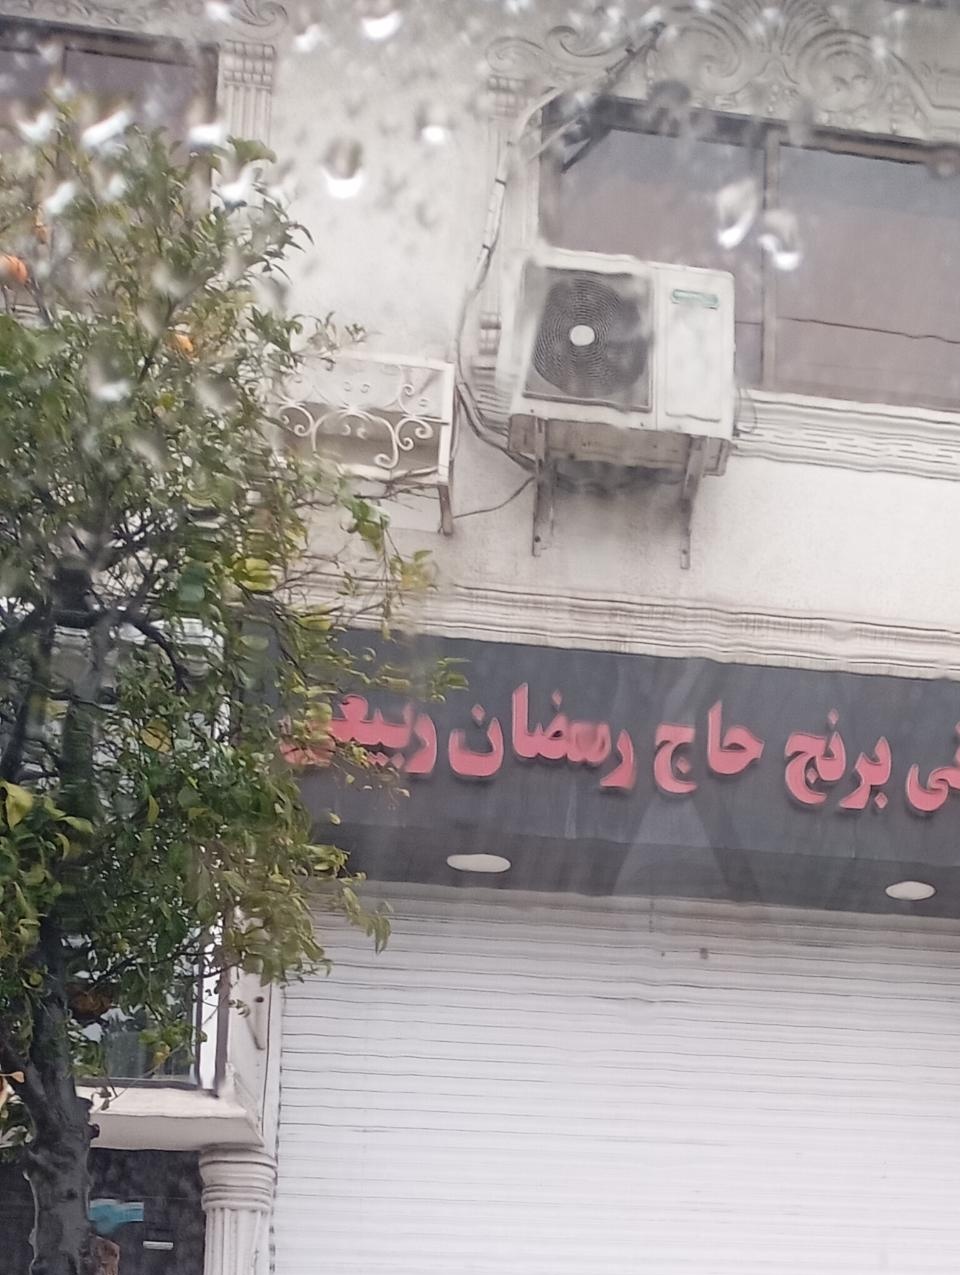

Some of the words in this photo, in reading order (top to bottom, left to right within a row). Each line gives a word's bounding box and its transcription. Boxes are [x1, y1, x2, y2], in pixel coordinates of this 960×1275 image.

[447, 681, 637, 790] رمضان
[653, 699, 765, 794] حاج
[784, 707, 891, 810] برنج
